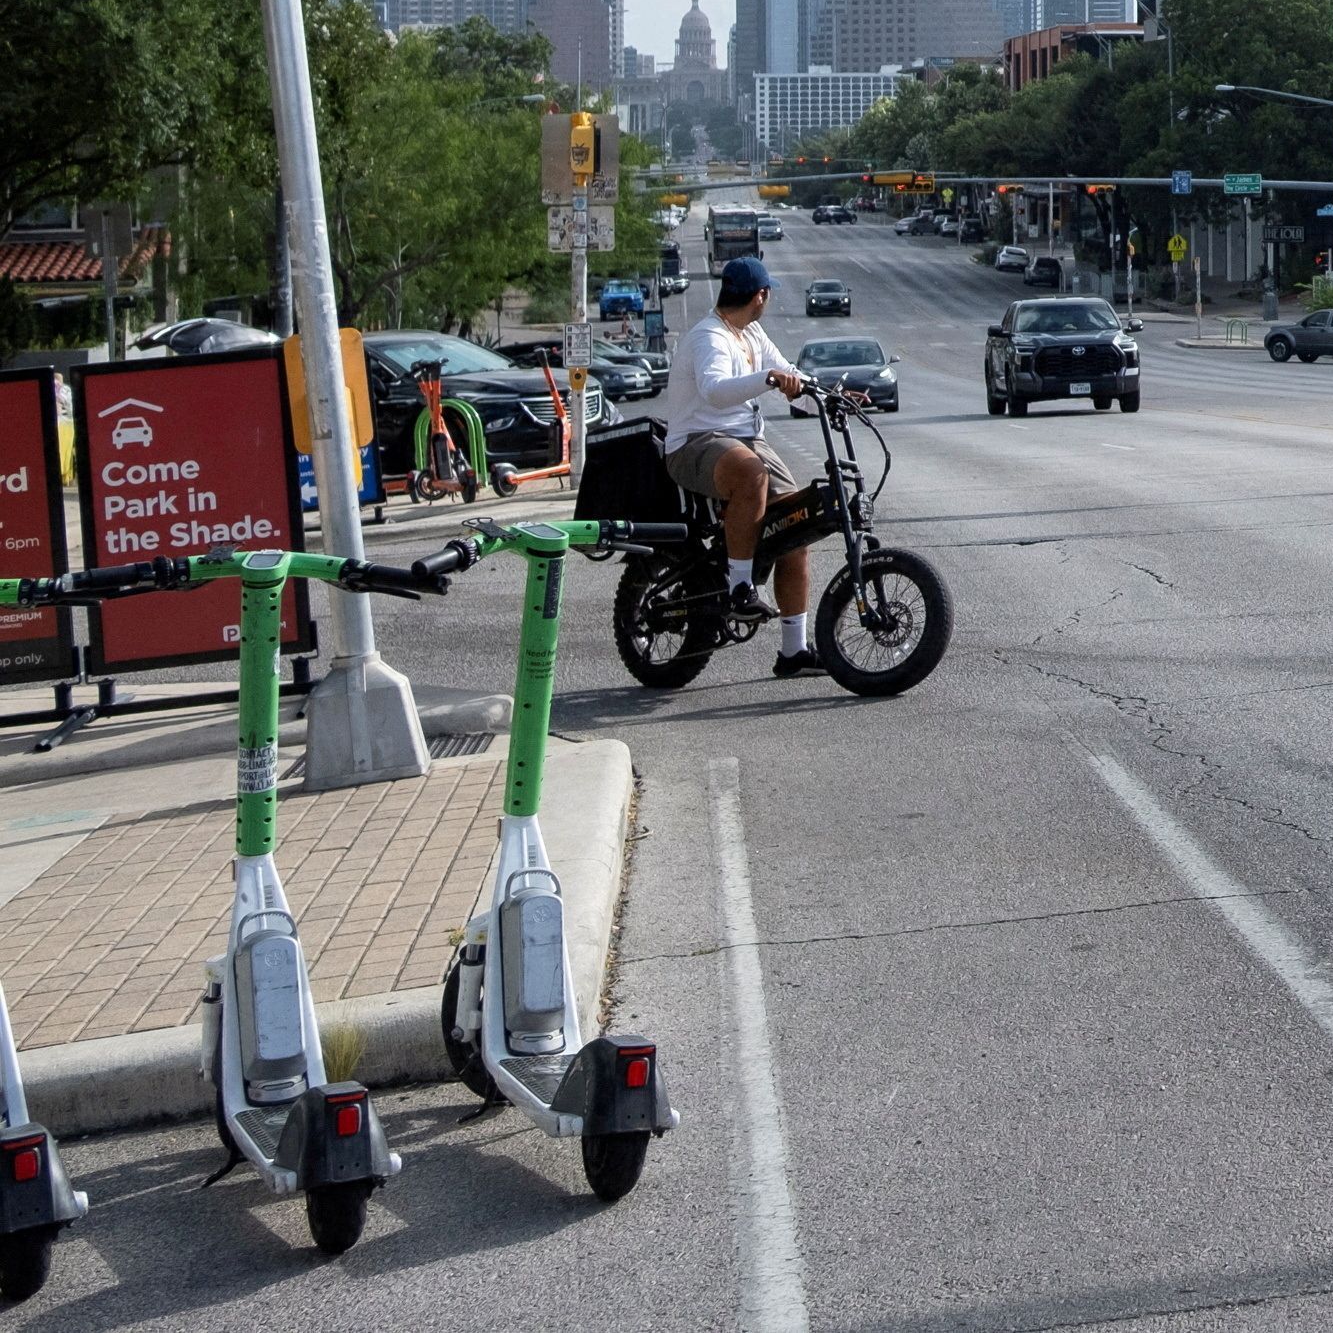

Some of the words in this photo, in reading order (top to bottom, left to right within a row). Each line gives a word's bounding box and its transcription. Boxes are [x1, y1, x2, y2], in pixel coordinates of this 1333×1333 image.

[101, 459, 200, 487] Come
[104, 490, 179, 520] Park
[188, 487, 217, 513] in
[5, 536, 40, 551] 6pm
[105, 527, 160, 554] the
[169, 515, 281, 548] Shade.
[14, 653, 45, 666] only.
